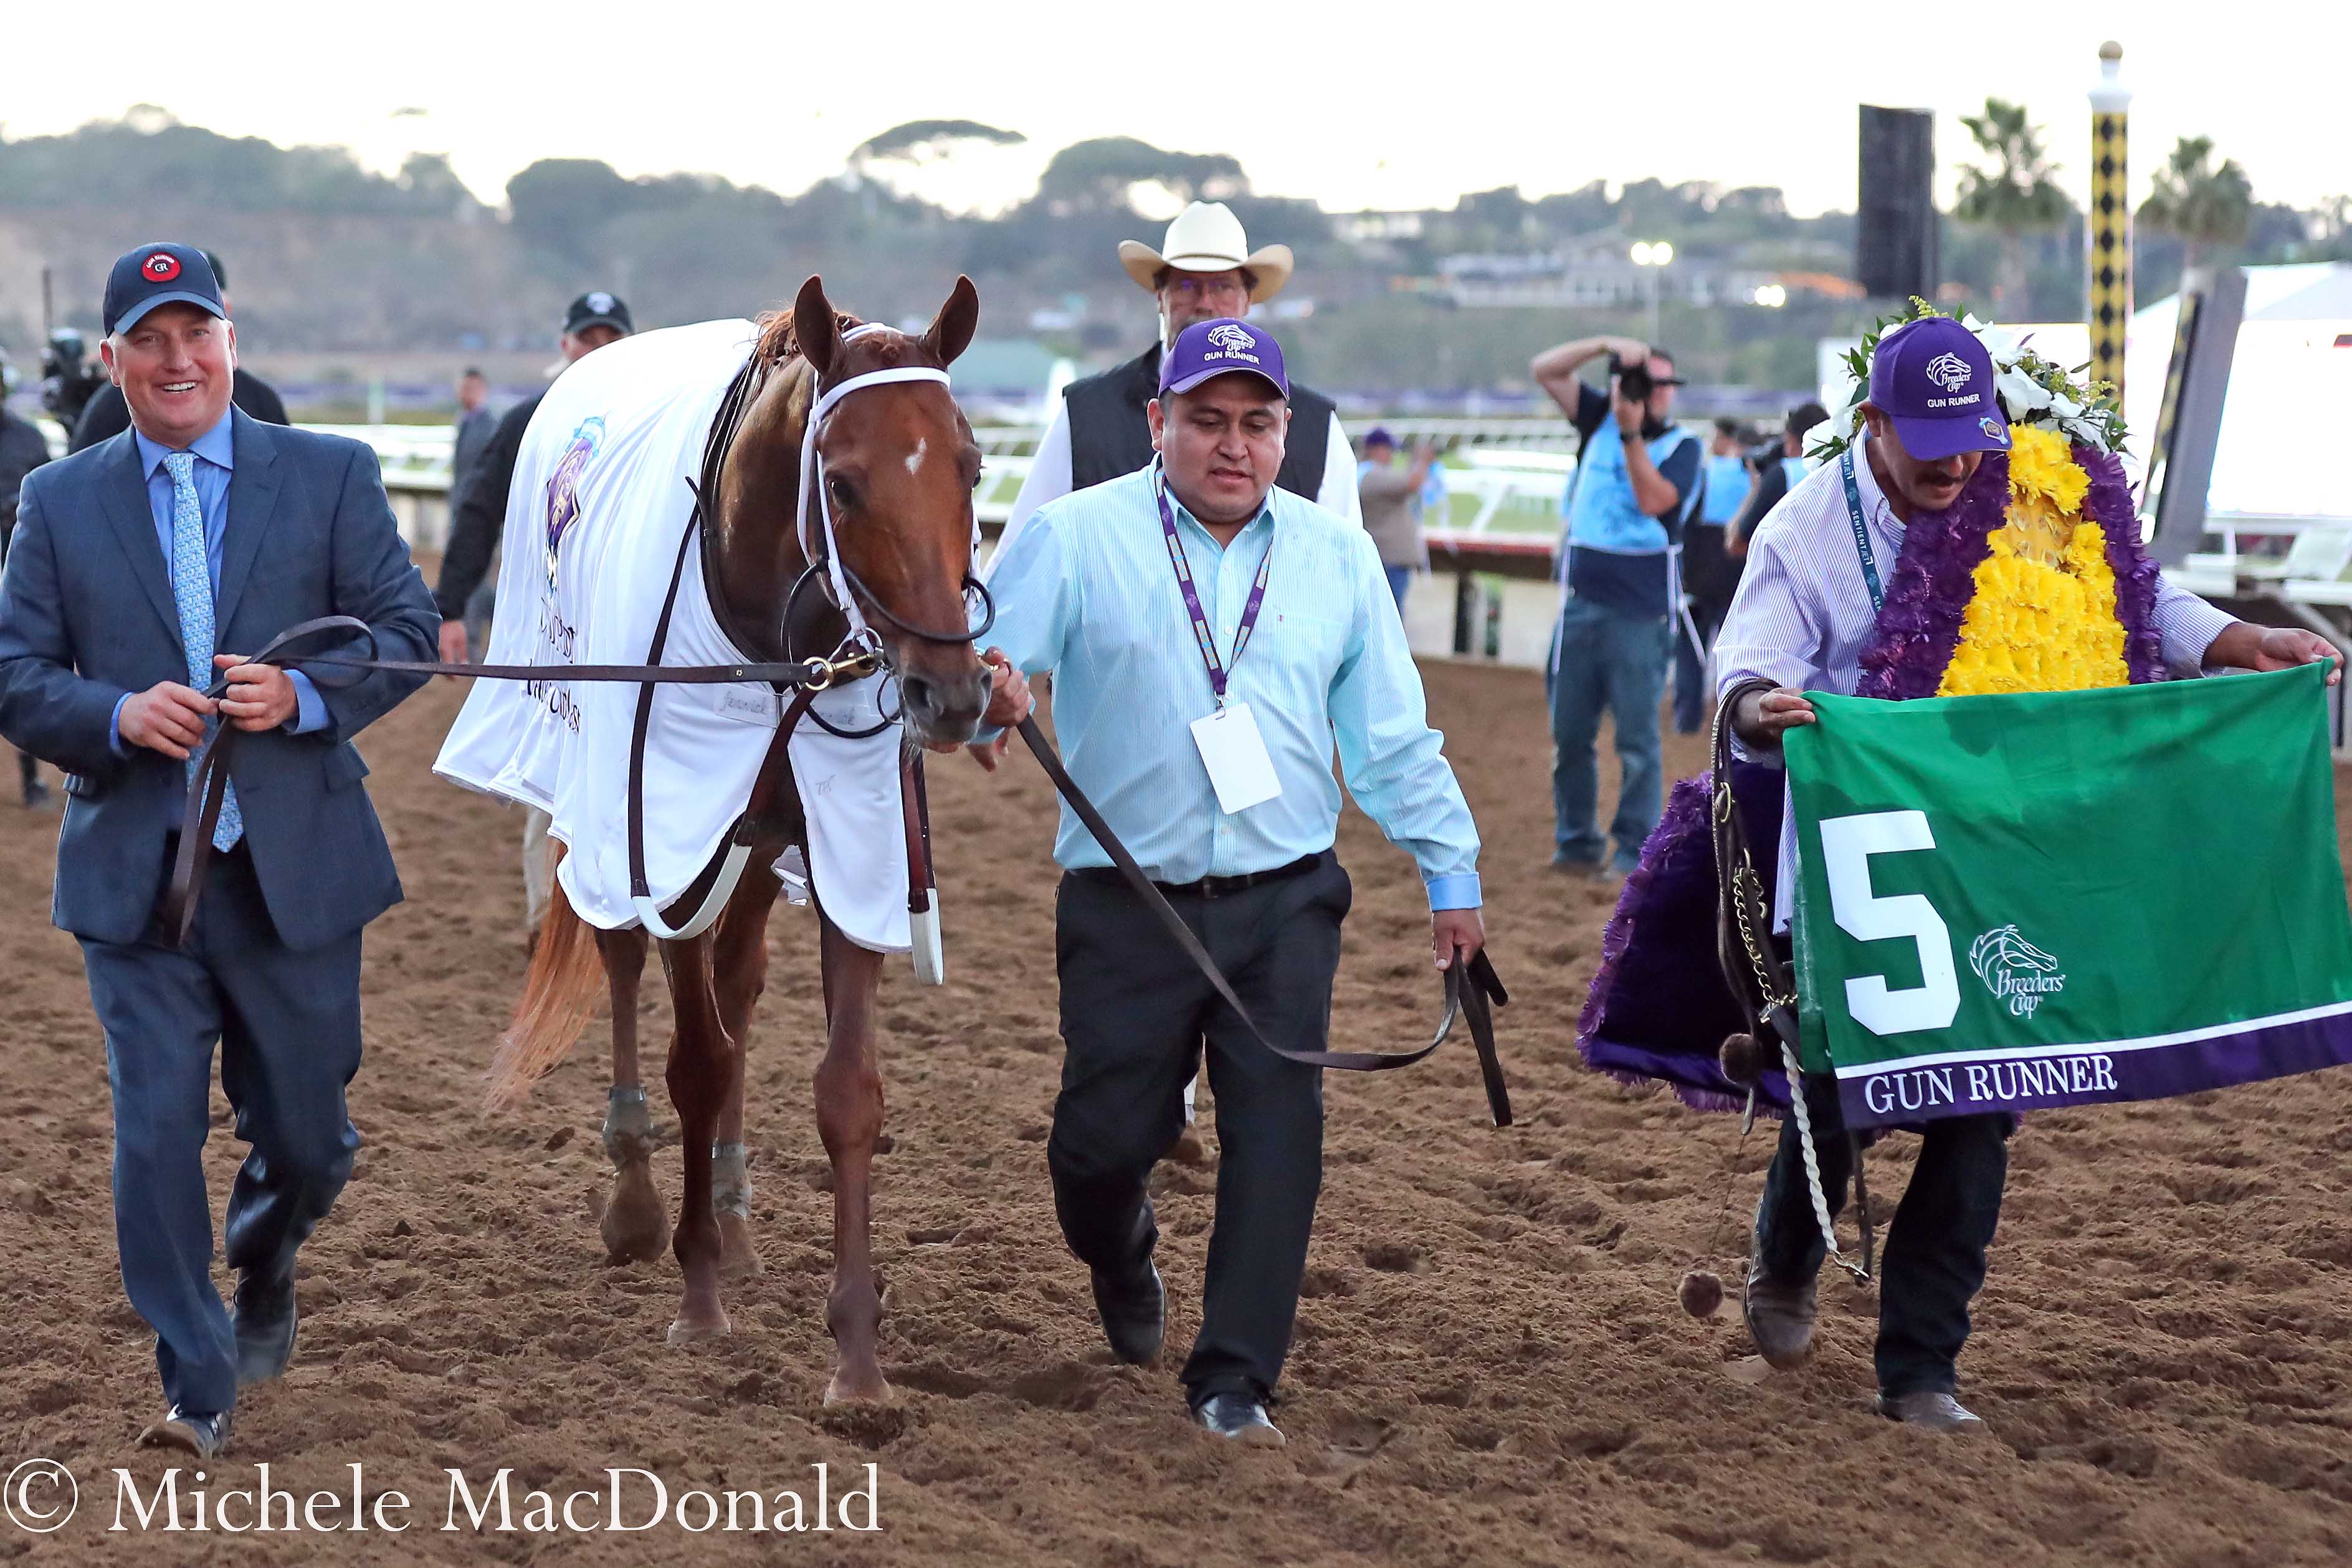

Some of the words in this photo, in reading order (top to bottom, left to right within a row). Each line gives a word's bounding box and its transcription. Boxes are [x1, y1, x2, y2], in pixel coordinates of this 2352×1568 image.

[1204, 351, 1223, 361] GUN
[1225, 351, 1260, 364] RUNNER
[1927, 398, 1946, 408] GUN
[1948, 394, 1980, 406] RUNNER
[1819, 810, 1961, 1035] 5
[1864, 1068, 1954, 1114] GUN
[1963, 1054, 2118, 1101] RUNNER
